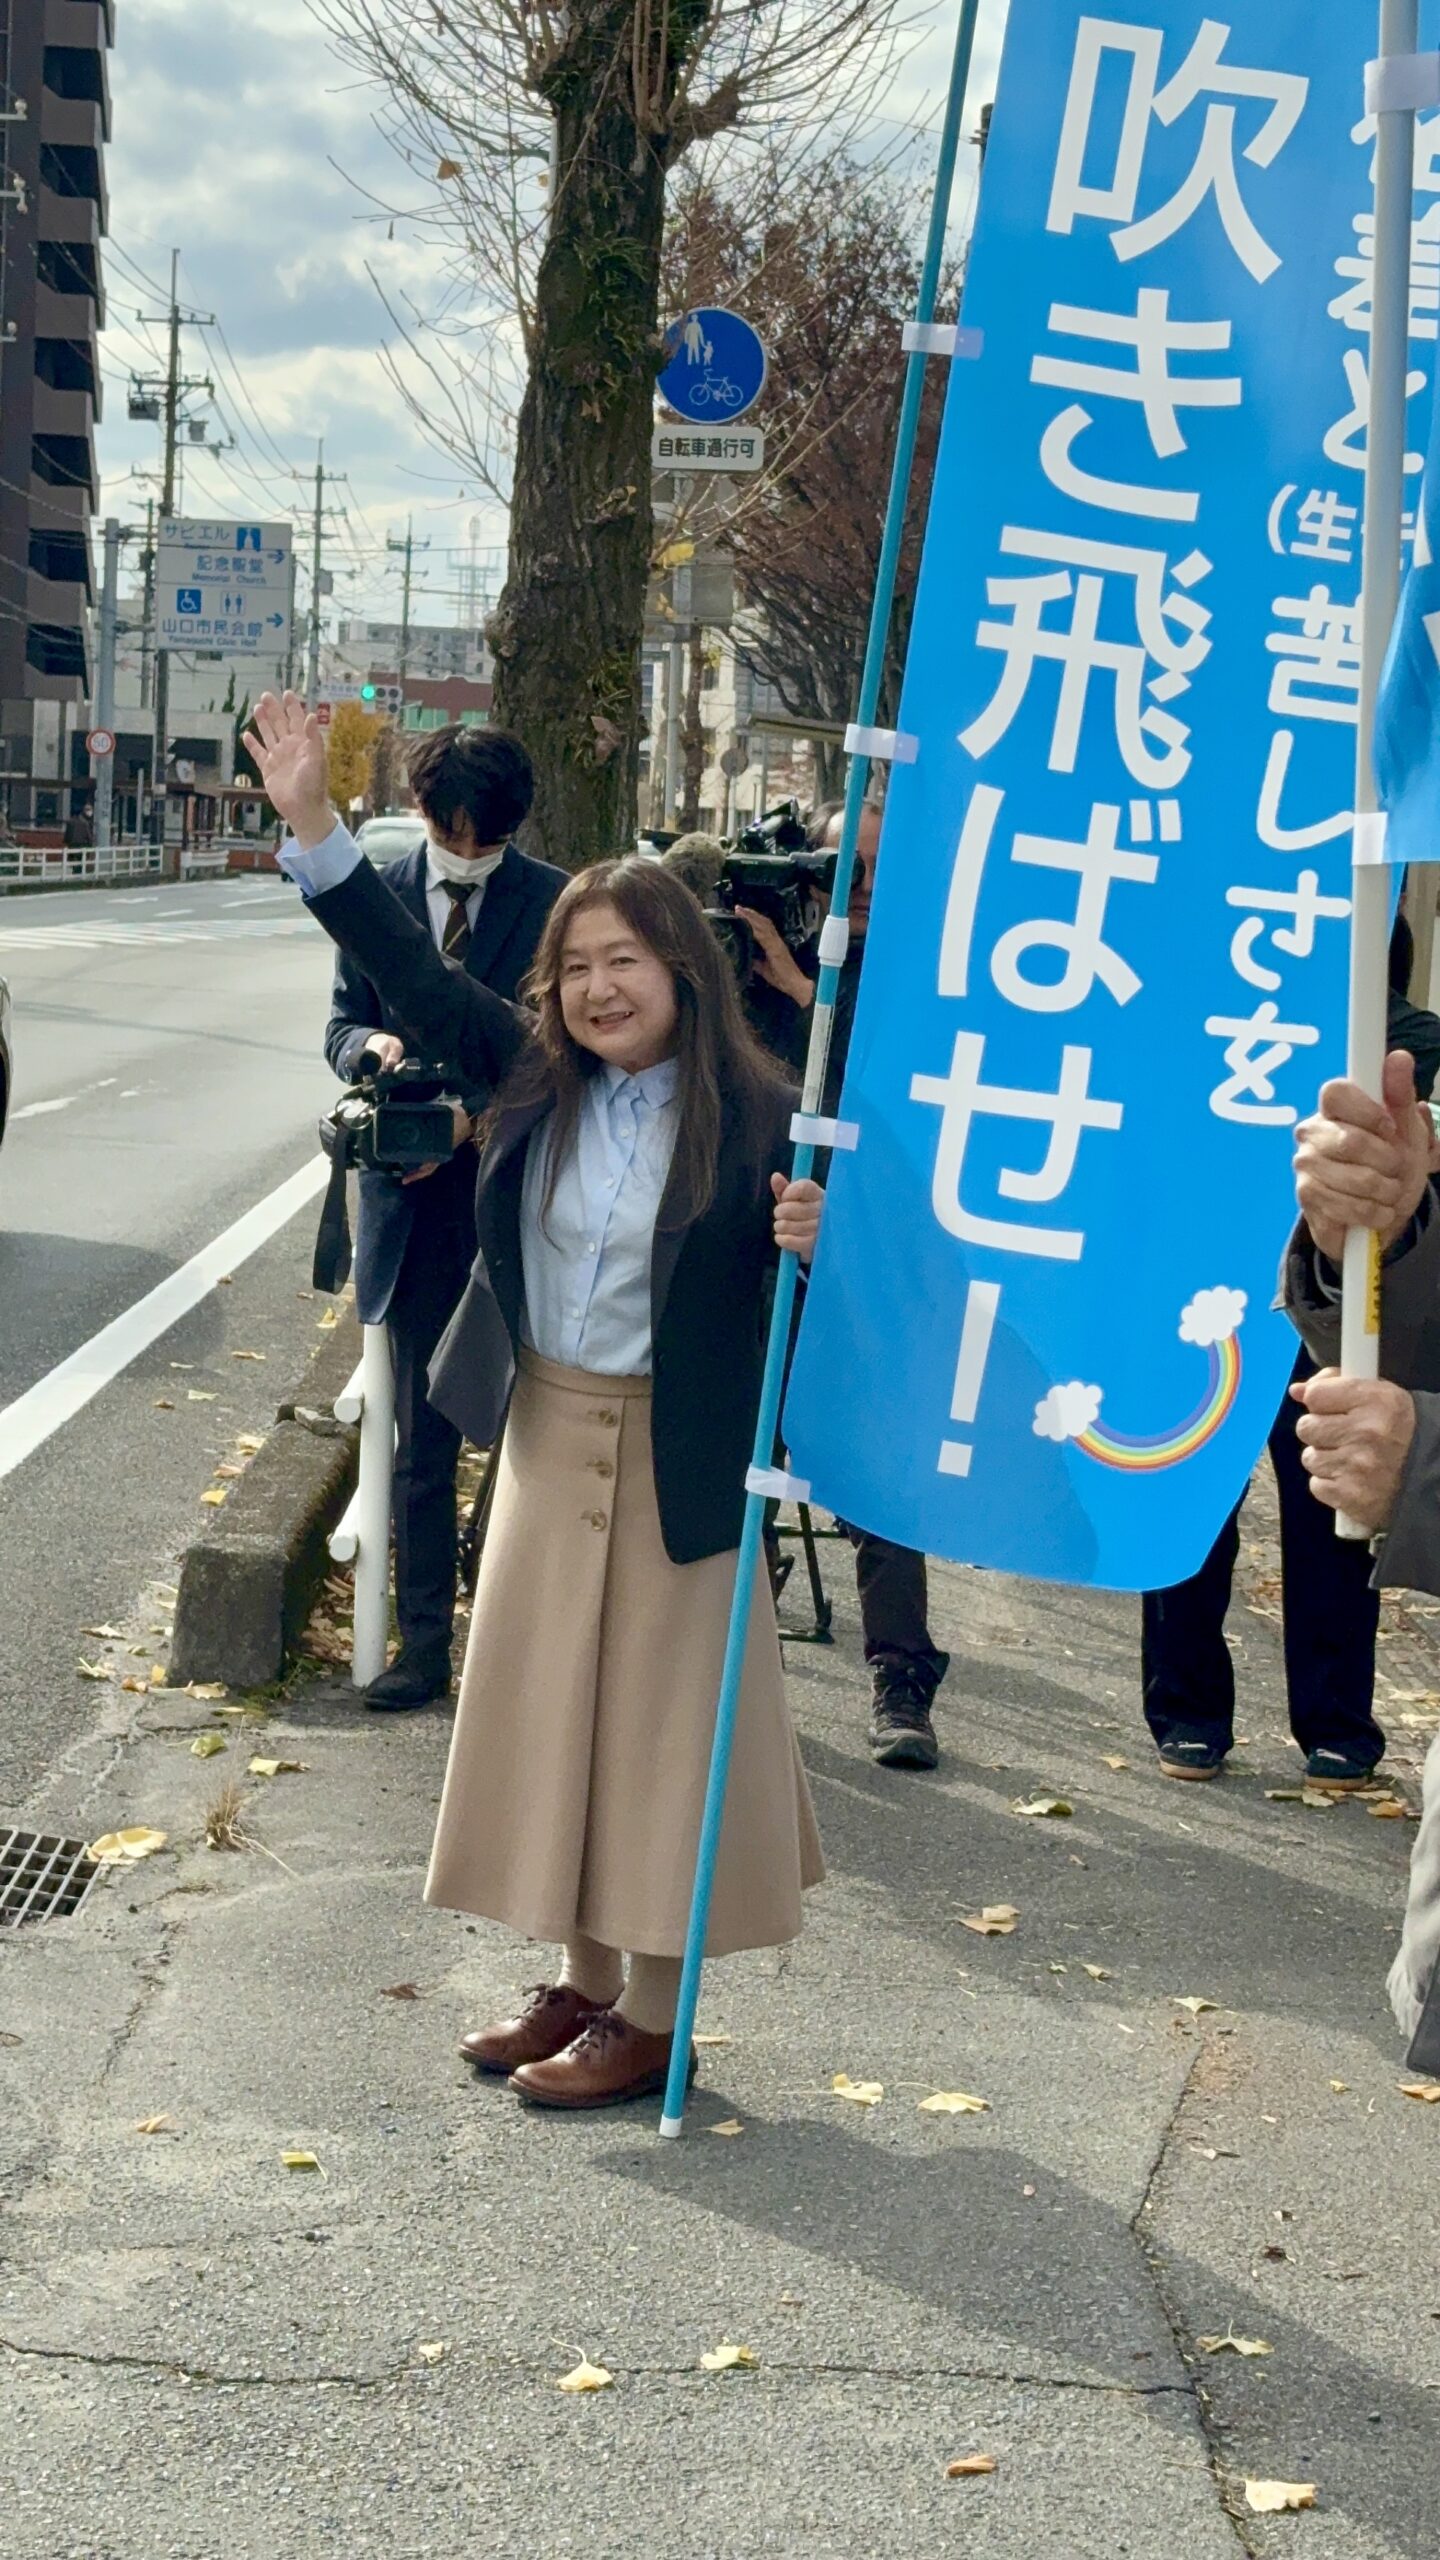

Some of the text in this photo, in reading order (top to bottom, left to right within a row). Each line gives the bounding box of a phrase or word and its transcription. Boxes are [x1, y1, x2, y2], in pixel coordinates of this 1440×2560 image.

[658, 437, 756, 459] 自転車通行可
[164, 523, 230, 540] サビエル
[162, 617, 263, 637] 山口市民会館
